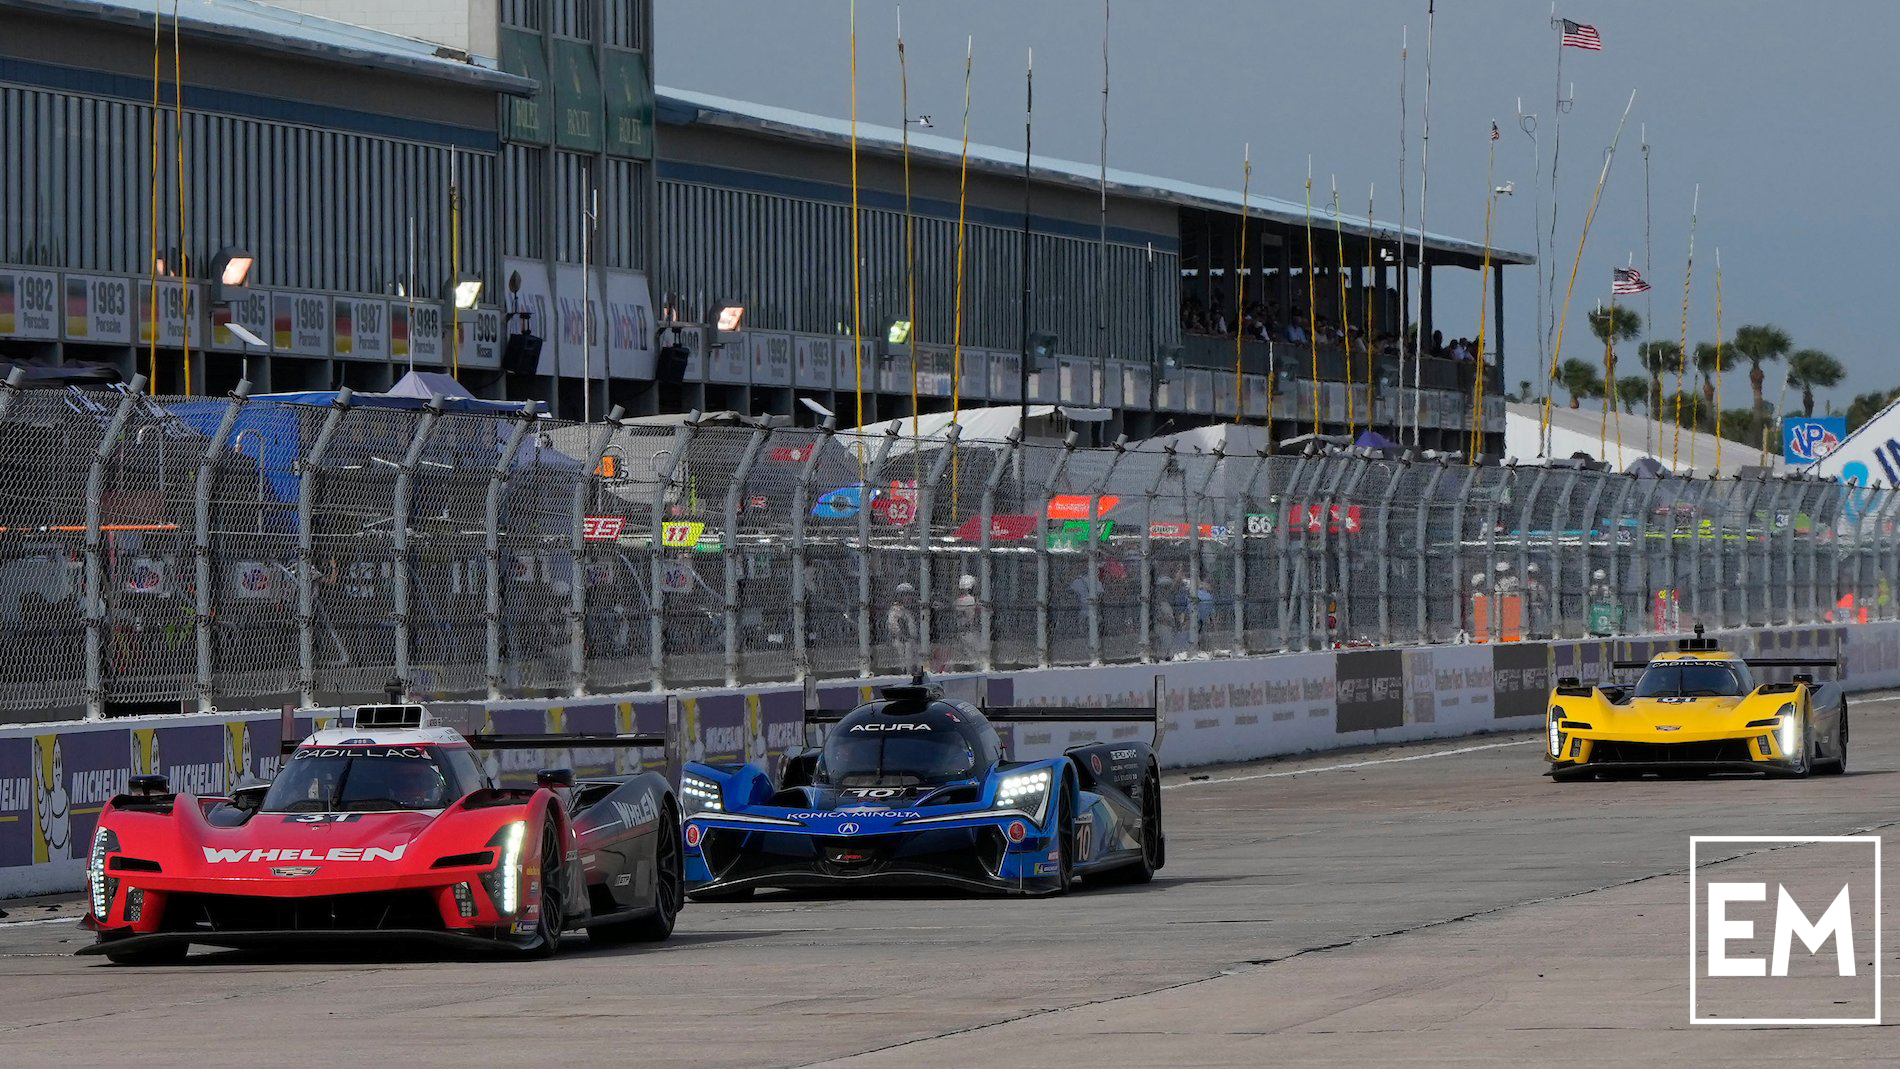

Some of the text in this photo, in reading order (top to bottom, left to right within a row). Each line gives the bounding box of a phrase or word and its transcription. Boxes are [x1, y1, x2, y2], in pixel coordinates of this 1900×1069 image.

[18, 276, 53, 312] 1982
[91, 281, 125, 315] 1983
[23, 312, 50, 330] Porsche
[96, 316, 121, 334] Porsche
[295, 298, 324, 331] 1986
[355, 303, 382, 334] 1987
[411, 308, 438, 338] 1988
[168, 320, 192, 338] Porsce
[766, 338, 788, 364] 1992
[1791, 423, 1825, 458] VP
[667, 527, 689, 542] 11
[1247, 516, 1273, 534] 66
[1652, 661, 1725, 669] CADILLAC
[849, 723, 932, 733] ACURA
[295, 748, 421, 760] CADILLAC
[72, 768, 130, 804] MICHELIN
[169, 762, 224, 795] MICHELIN
[0, 778, 30, 811] ELIN
[852, 789, 895, 798] 10
[296, 813, 350, 823] 31
[611, 787, 659, 830] WHELEN
[786, 811, 921, 820] KONICA MINOLTA
[202, 843, 408, 863] WHELEN
[1076, 824, 1092, 861] 10
